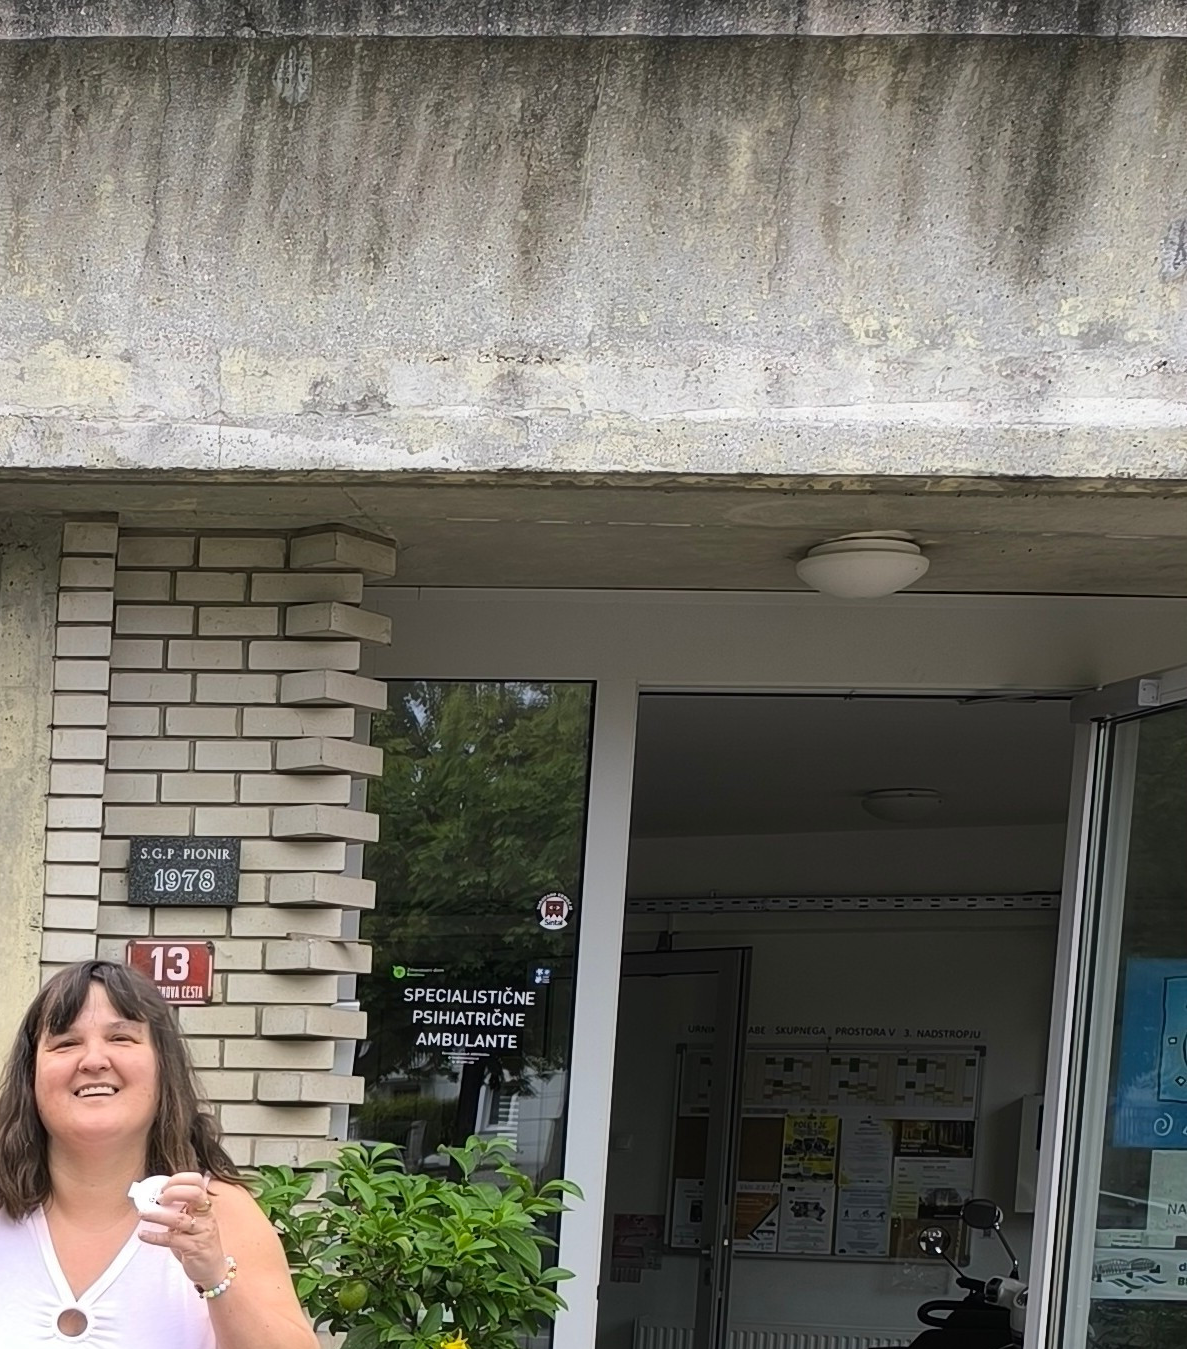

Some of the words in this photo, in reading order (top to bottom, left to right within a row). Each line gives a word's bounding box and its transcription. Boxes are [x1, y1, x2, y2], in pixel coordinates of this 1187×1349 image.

[183, 848, 231, 860] PIONIR
[153, 868, 216, 892] 1978
[150, 946, 190, 982] 13
[157, 985, 180, 999] NOVA
[181, 986, 203, 999] CESTA
[403, 987, 536, 1006] SPECIALISTIČNE
[412, 1008, 526, 1027] PSIHIATRIČNE
[415, 1032, 518, 1049] AMBULANTE
[748, 1025, 767, 1035] ABE
[774, 1025, 826, 1036] SKUPNEGA
[835, 1026, 887, 1037] PROSTORA
[888, 1027, 897, 1037] V
[904, 1028, 913, 1038] 3.
[917, 1028, 982, 1040] NADSTROPJU
